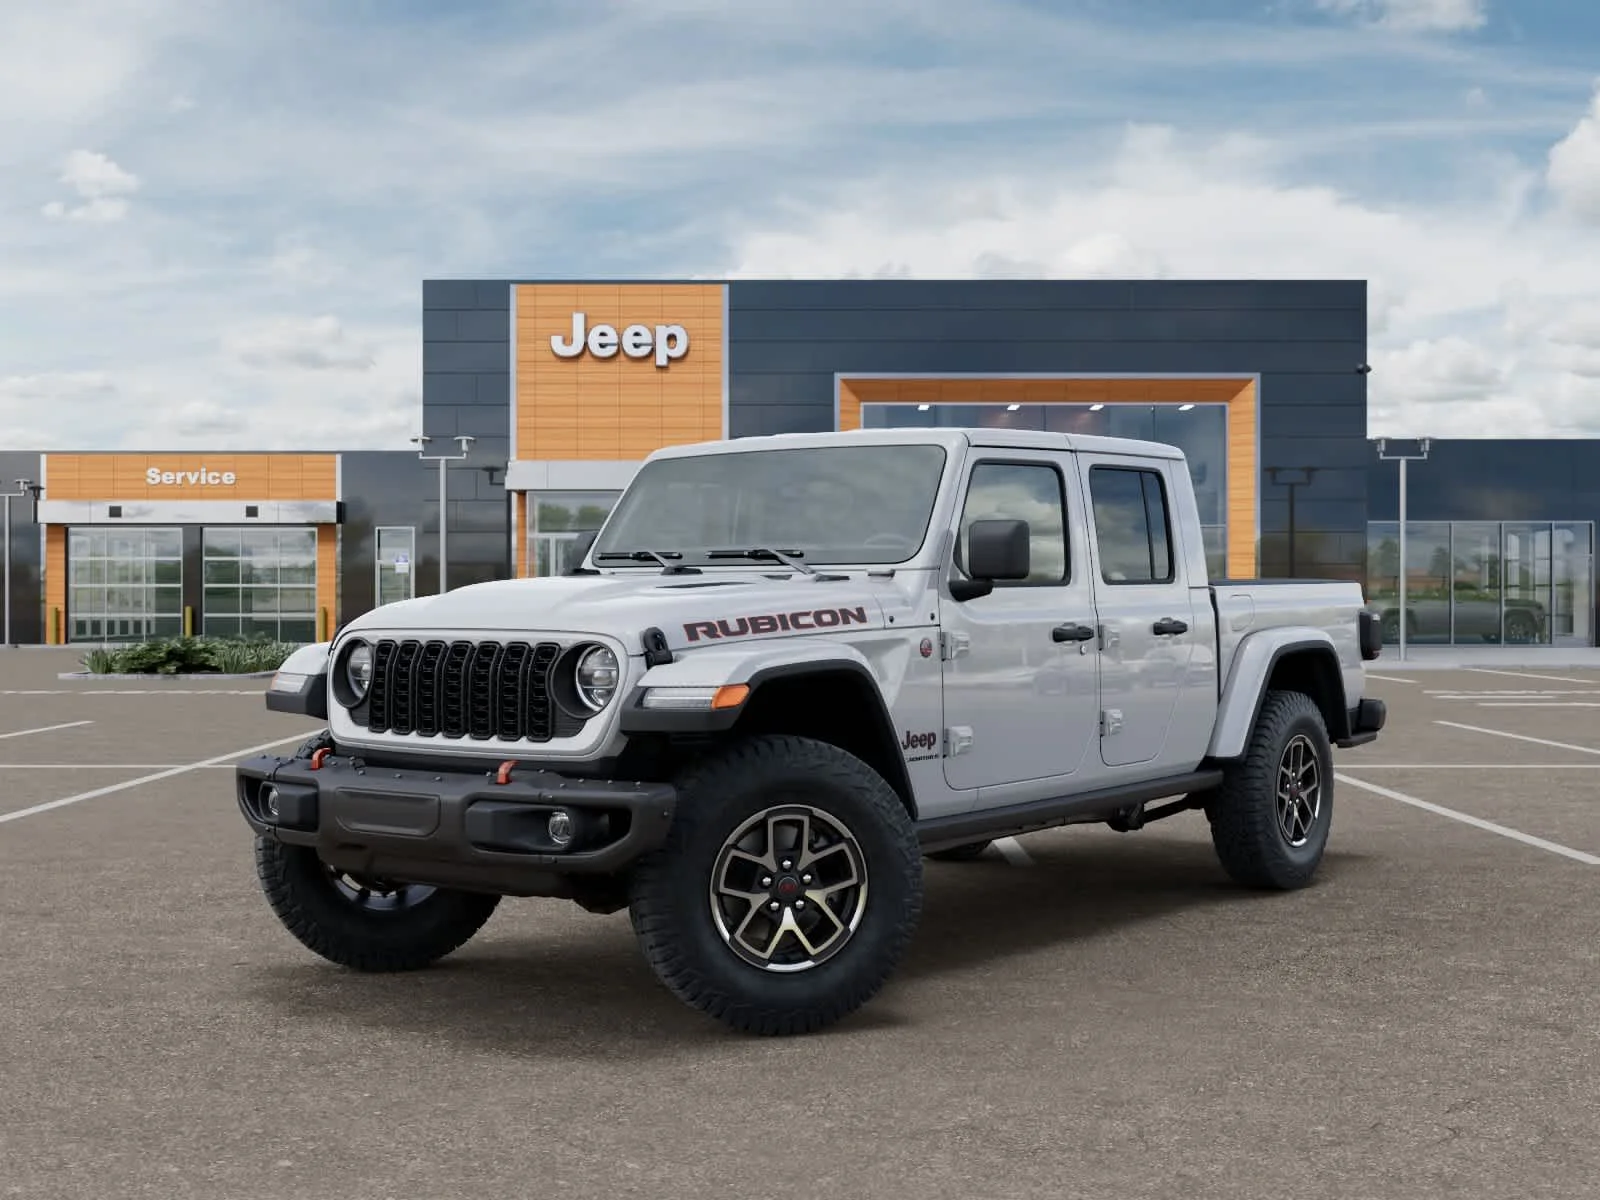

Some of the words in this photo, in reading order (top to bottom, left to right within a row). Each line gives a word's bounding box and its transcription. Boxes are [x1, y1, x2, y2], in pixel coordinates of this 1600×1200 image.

[550, 312, 690, 368] Jeep
[145, 467, 236, 486] Service
[683, 606, 867, 642] RUBICON
[902, 730, 936, 750] Jeep
